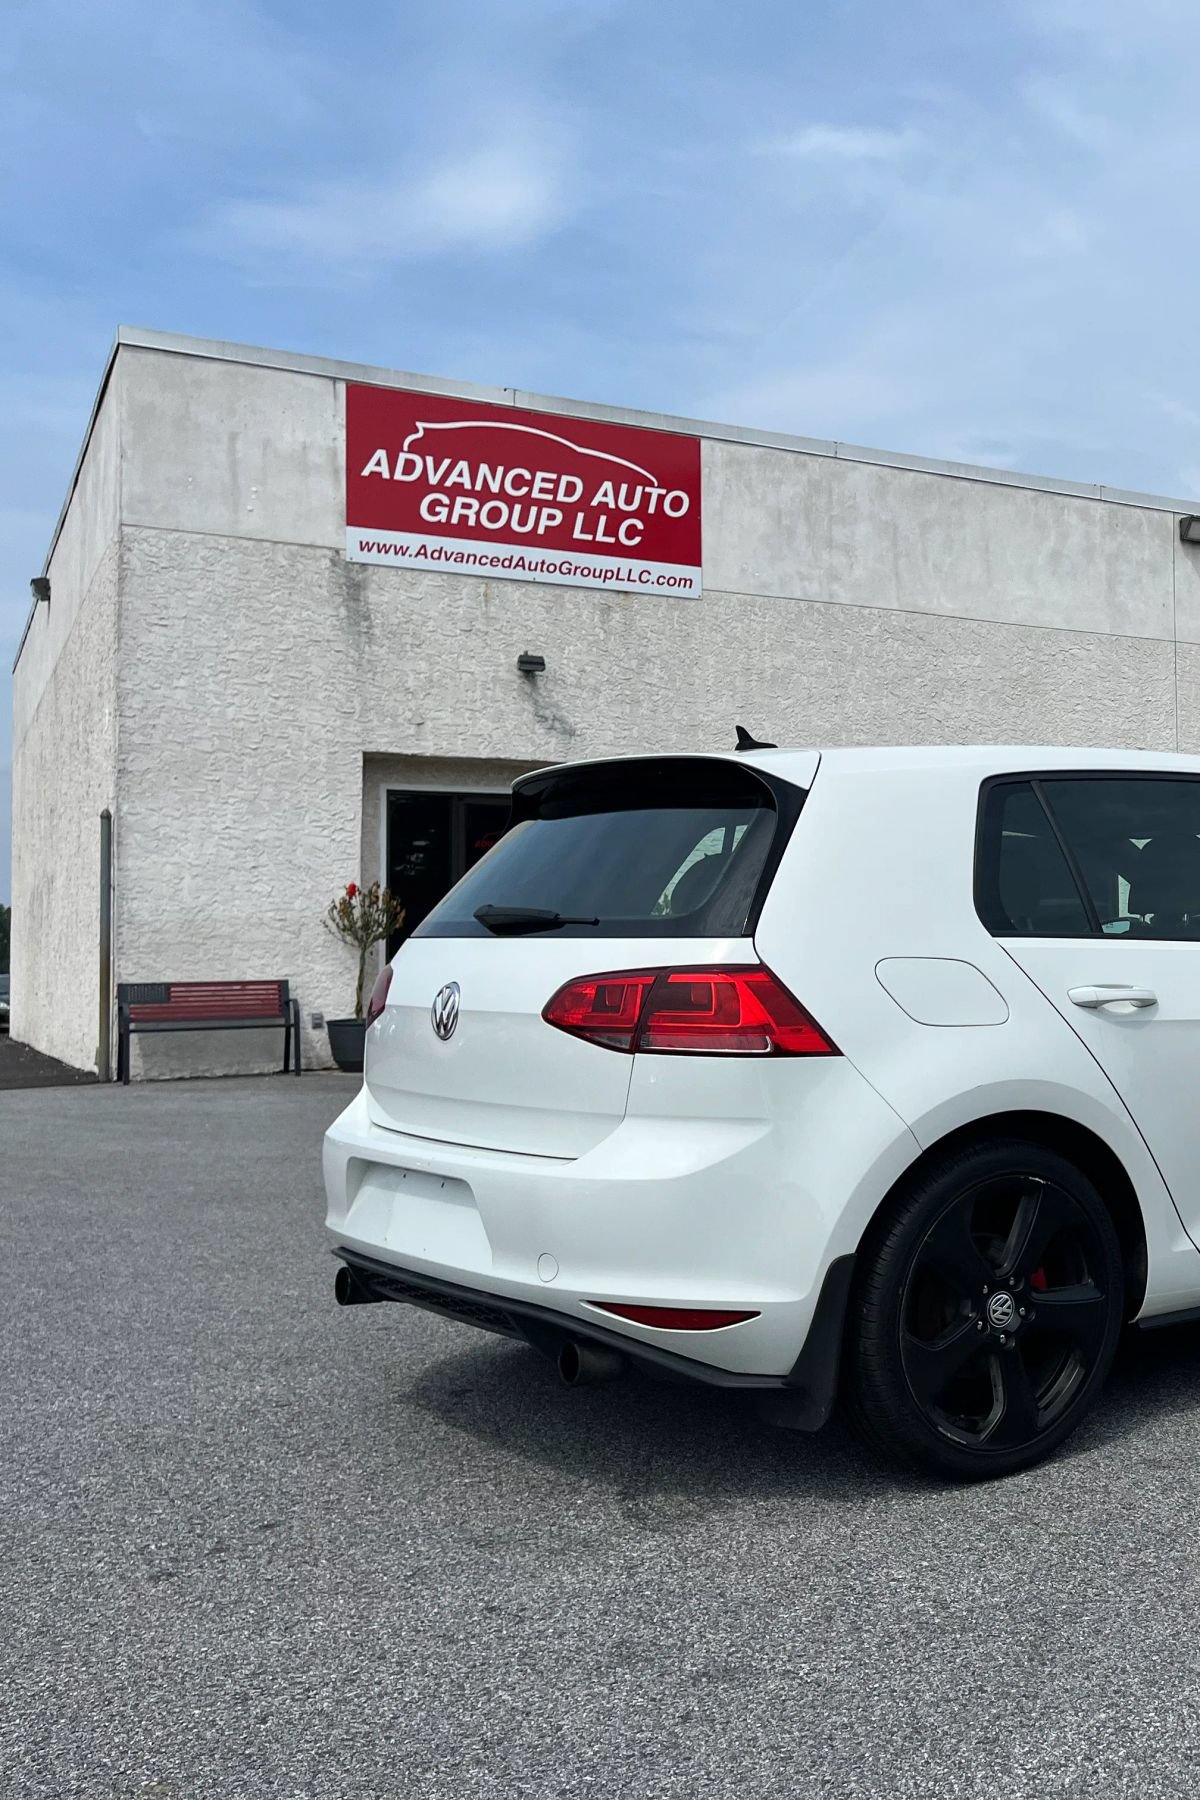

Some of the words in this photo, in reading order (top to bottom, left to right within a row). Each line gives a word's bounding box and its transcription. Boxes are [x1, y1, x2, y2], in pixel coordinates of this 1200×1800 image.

[361, 448, 583, 503] ADVANCED
[590, 480, 691, 518] AUTO
[419, 493, 563, 535] GROUP
[572, 514, 645, 546] LLC
[358, 539, 694, 590] www.AdvancedAutoGroupLLC.com
